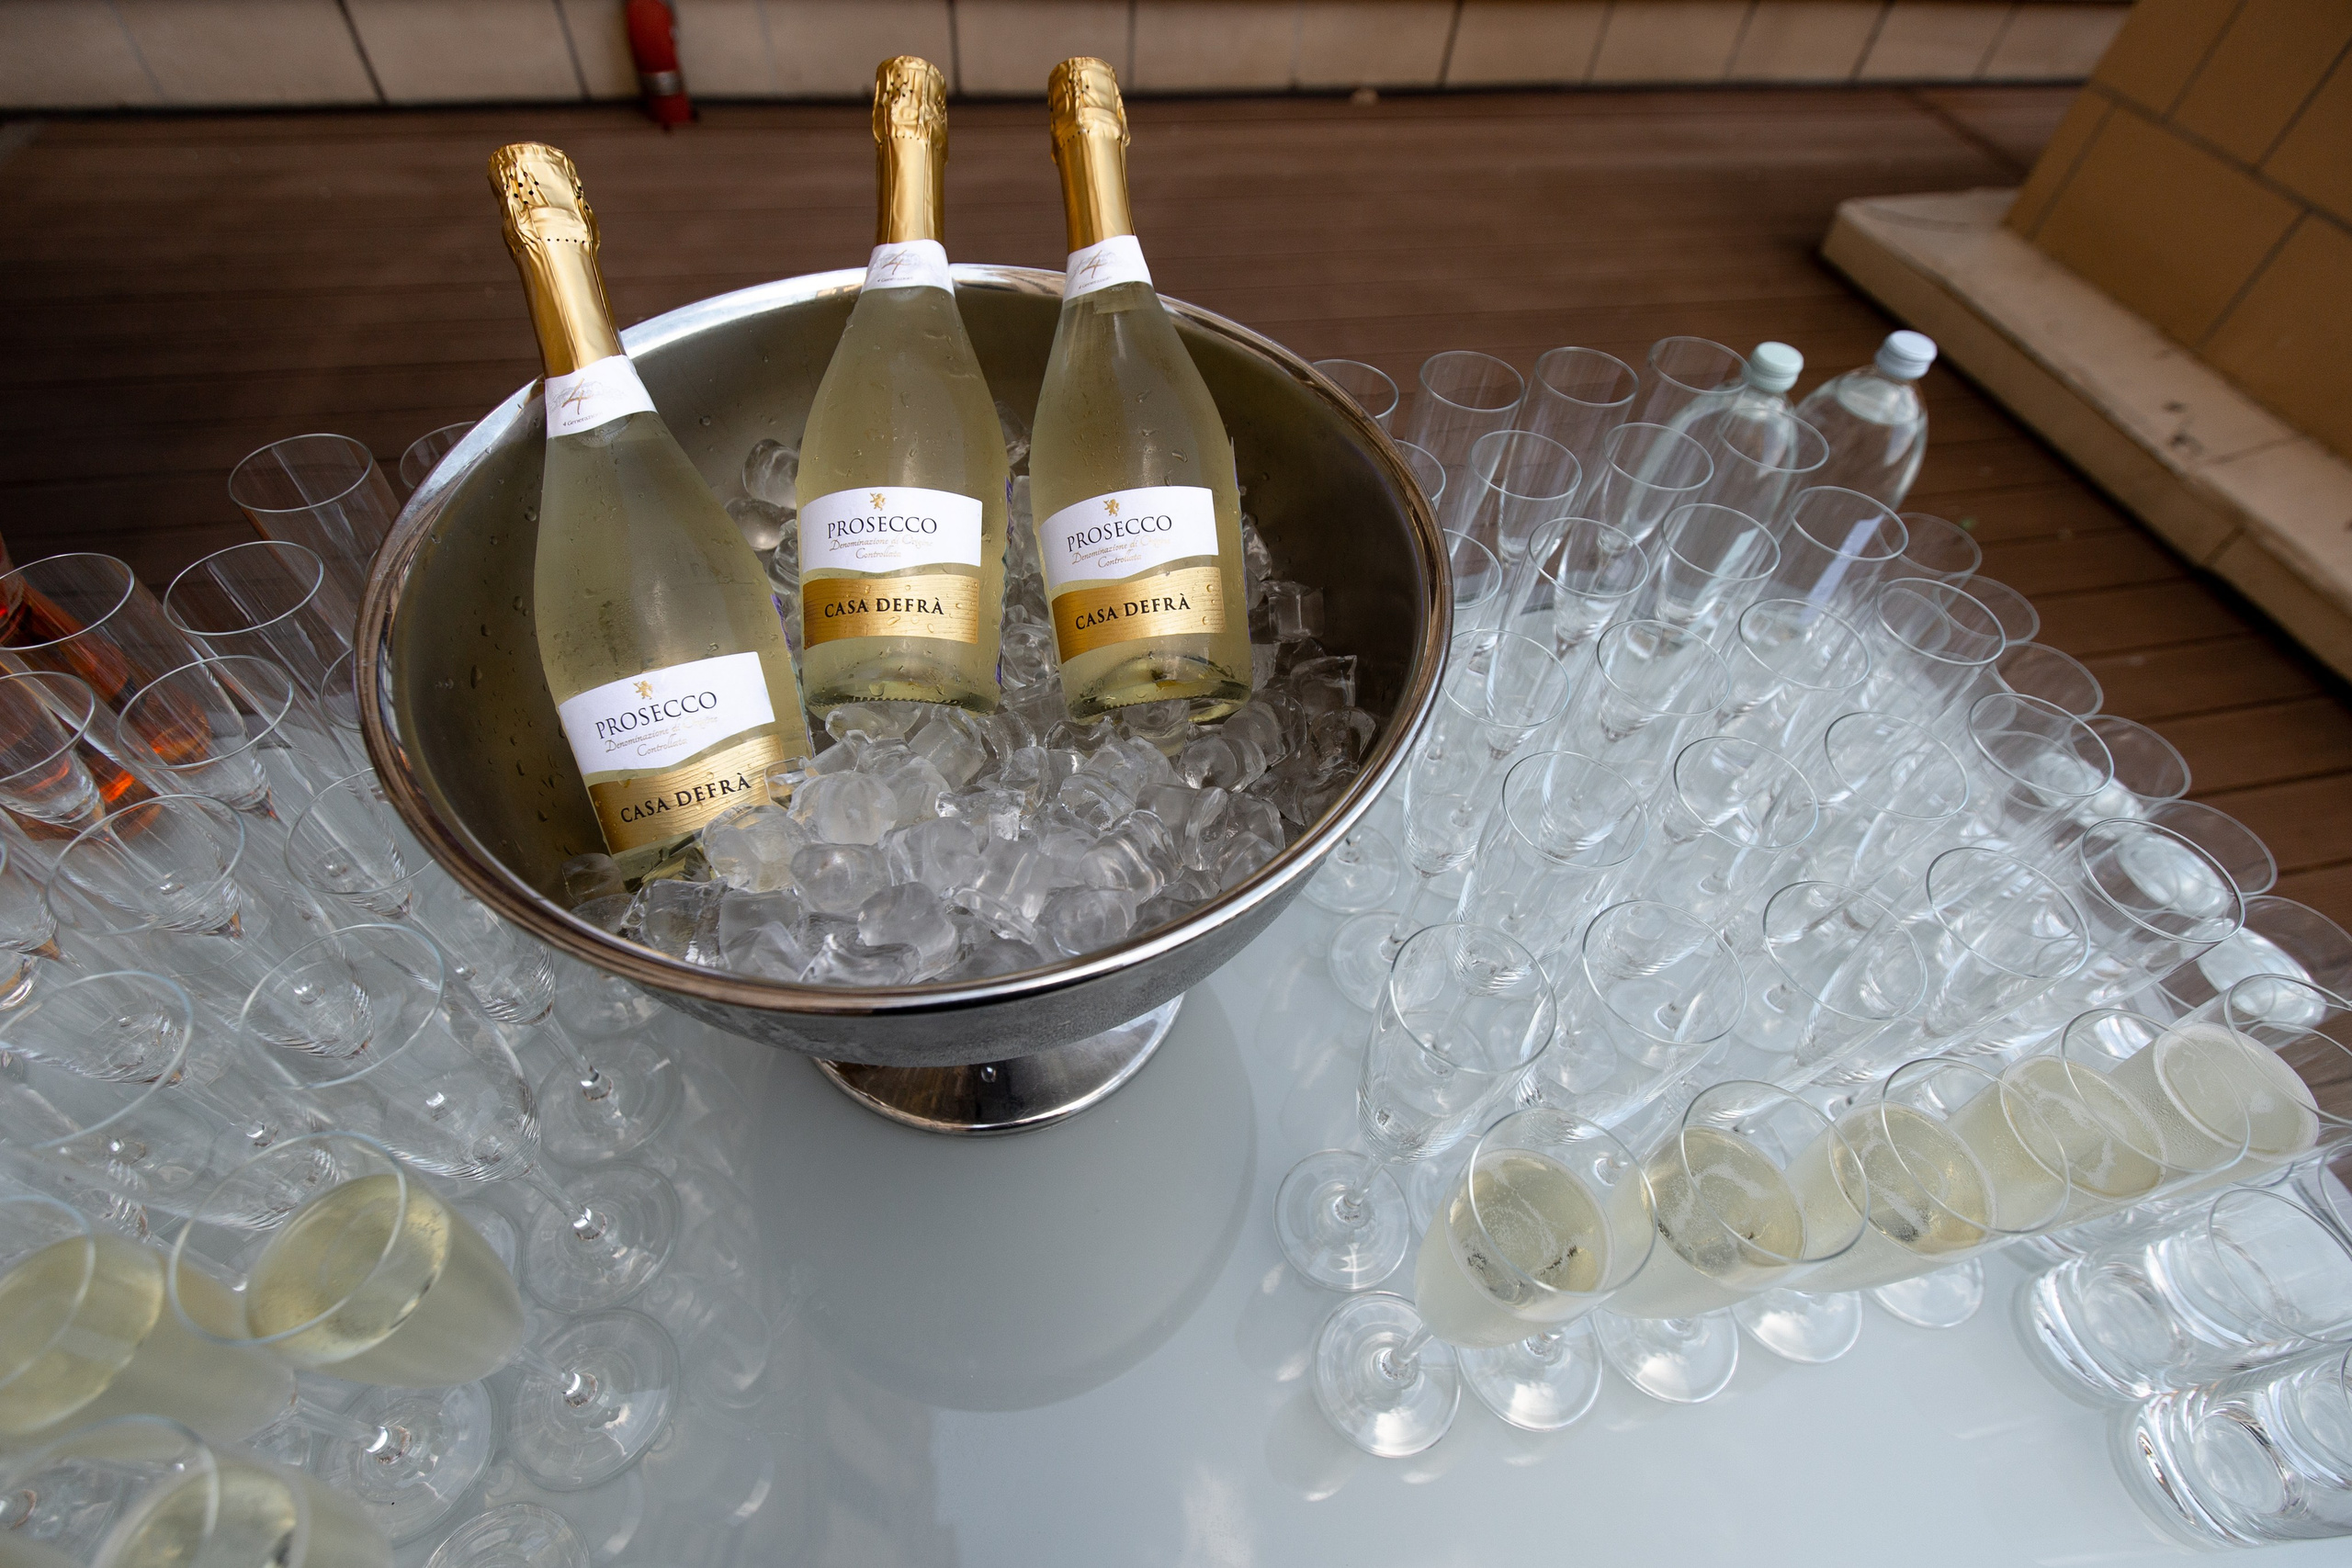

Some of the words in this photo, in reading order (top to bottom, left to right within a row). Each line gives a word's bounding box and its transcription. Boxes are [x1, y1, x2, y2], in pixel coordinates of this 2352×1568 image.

[1079, 249, 1108, 279] 4
[560, 377, 594, 416] 4
[827, 515, 938, 539] PROSECCO
[1066, 514, 1173, 553] PROSECCO
[829, 537, 889, 552] Denominazione
[854, 545, 902, 560] Controllata
[1071, 542, 1128, 565] Denominazione
[824, 598, 870, 618] CASA
[876, 597, 944, 615] DEFRÀ
[1074, 605, 1119, 630] CASA
[1123, 592, 1192, 617] DEFRÀ
[594, 691, 718, 739] PROSECCO
[604, 727, 670, 753] Denominazione
[636, 732, 688, 757] Controllata
[619, 796, 671, 824] CASA
[673, 772, 752, 807] DEFRÀ
